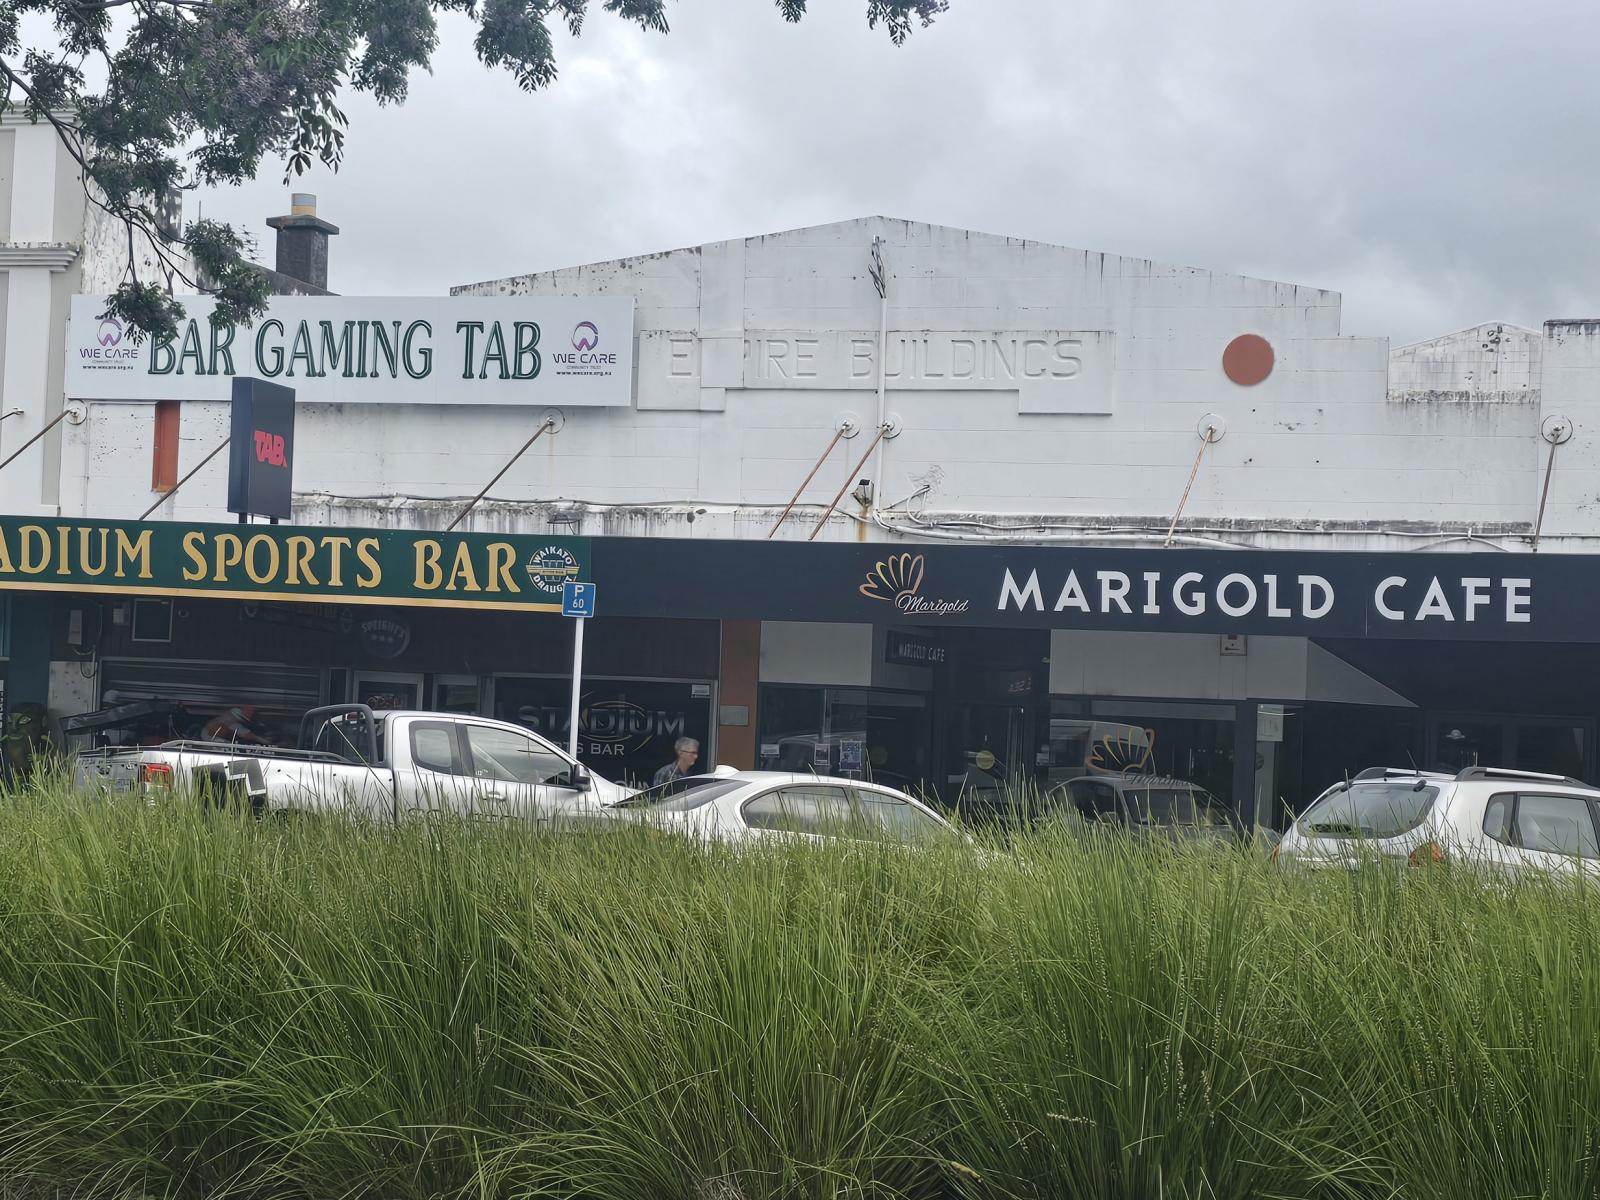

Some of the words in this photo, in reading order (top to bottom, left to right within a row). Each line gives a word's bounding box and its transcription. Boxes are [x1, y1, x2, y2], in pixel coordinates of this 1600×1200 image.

[79, 348, 101, 358] WE
[104, 348, 138, 359] CARE
[147, 317, 236, 376] BAR
[254, 318, 433, 379] GAMING
[456, 320, 541, 381] TAB
[552, 353, 576, 364] WE
[580, 353, 617, 364] CARE
[668, 338, 819, 379] EIRE
[254, 430, 288, 468] TAB
[182, 531, 382, 589] SPORTS
[412, 539, 521, 593] BAR
[533, 546, 573, 565] WAIKATO
[533, 575, 573, 593] DRAUGT
[574, 585, 584, 598] P
[572, 598, 584, 609] 60
[997, 566, 1335, 619] MARIGOLD
[1374, 576, 1531, 623] CAFE
[897, 594, 969, 616] Marigold
[928, 647, 945, 663] CAFE
[518, 703, 687, 737] STADIUM
[590, 742, 625, 756] BAR
